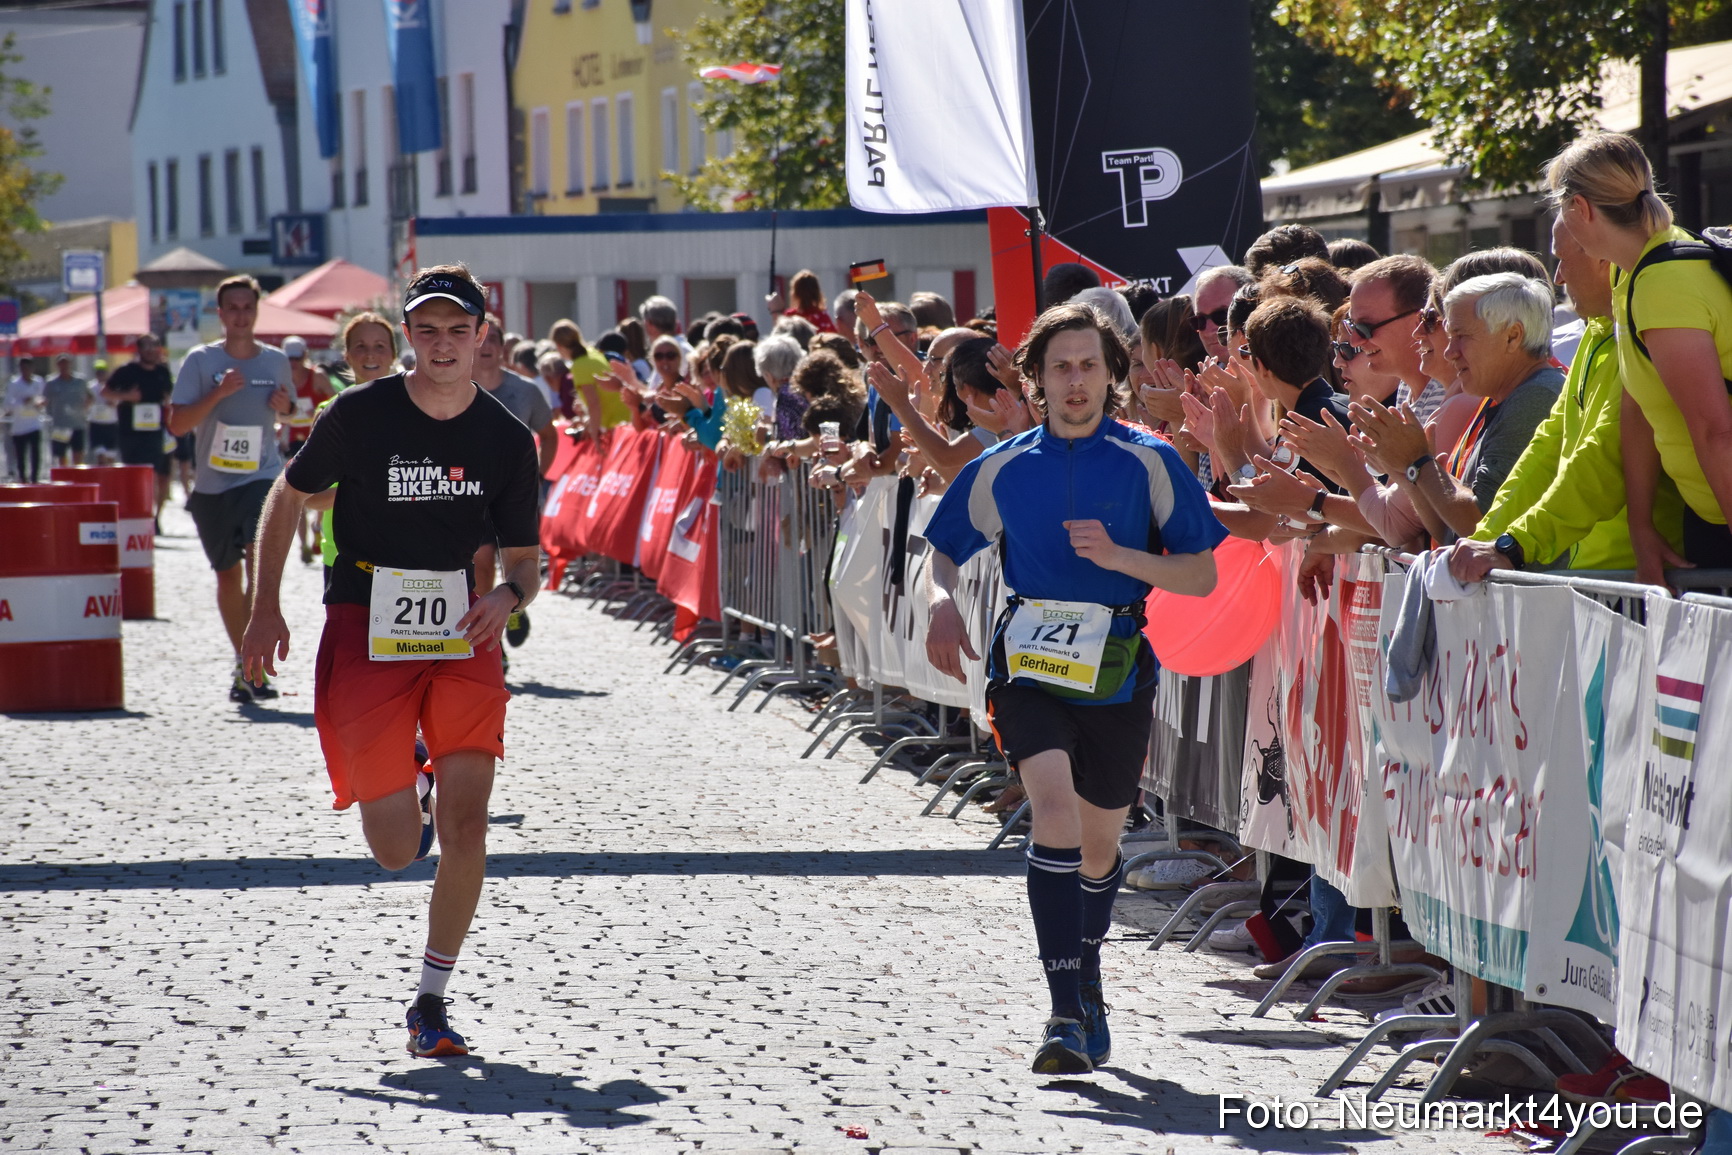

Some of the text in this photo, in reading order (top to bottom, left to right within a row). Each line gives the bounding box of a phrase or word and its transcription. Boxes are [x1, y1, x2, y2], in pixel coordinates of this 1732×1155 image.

[1108, 157, 1131, 166] Team
[223, 439, 250, 455] 149
[389, 454, 418, 466] Born
[388, 466, 448, 481] SWIM.
[402, 579, 443, 589] BOCK
[394, 597, 447, 626] 210
[1031, 622, 1080, 646] 121
[396, 642, 444, 653] Michael
[1018, 643, 1070, 656] PARTL Neumarkt
[1020, 655, 1070, 676] Gerhard
[1047, 957, 1081, 972] JAKO
[1560, 957, 1588, 989] Jura
